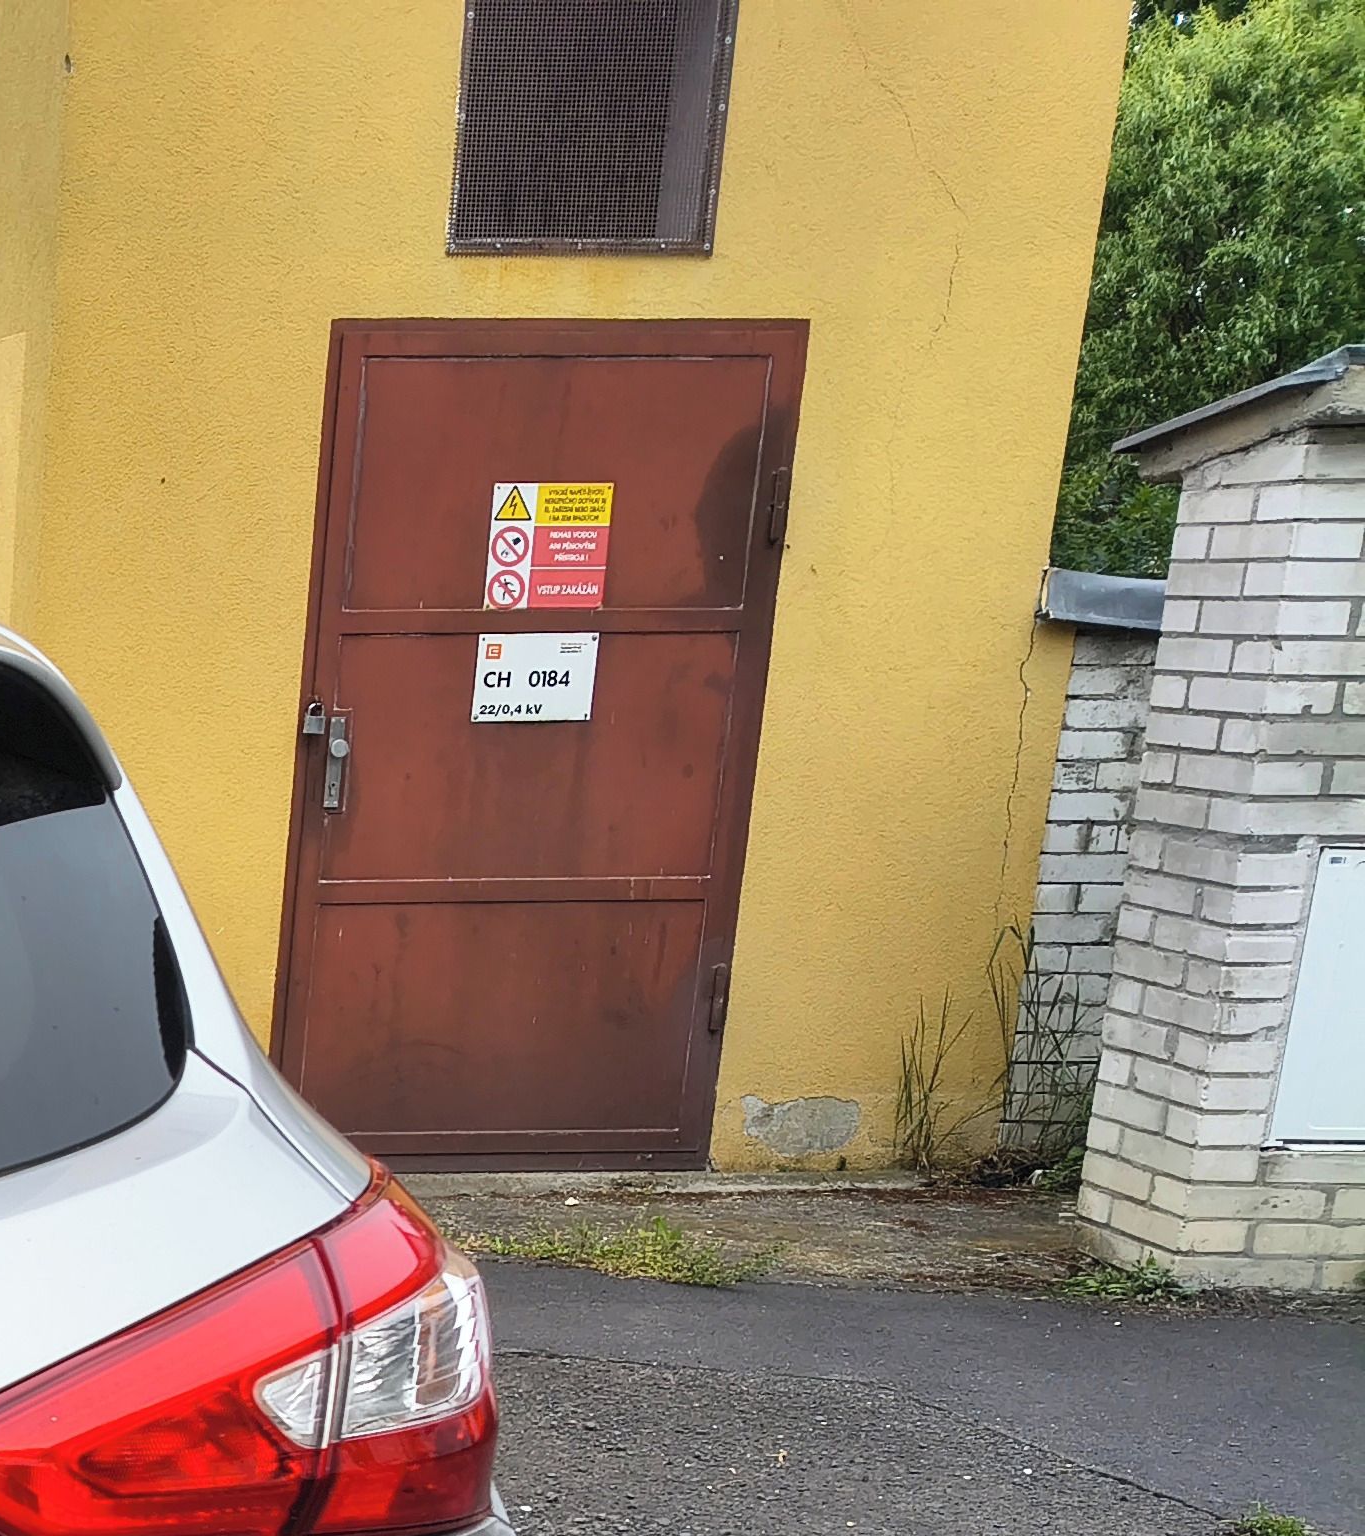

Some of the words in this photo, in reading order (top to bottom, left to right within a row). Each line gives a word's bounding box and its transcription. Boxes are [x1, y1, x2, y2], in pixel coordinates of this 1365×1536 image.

[537, 584, 561, 595] VSTUP
[561, 582, 599, 595] ZAKÁZÁN
[483, 671, 512, 688] CH
[528, 670, 570, 688] 0184
[479, 704, 522, 717] 22/0,4
[525, 704, 542, 715] kV
